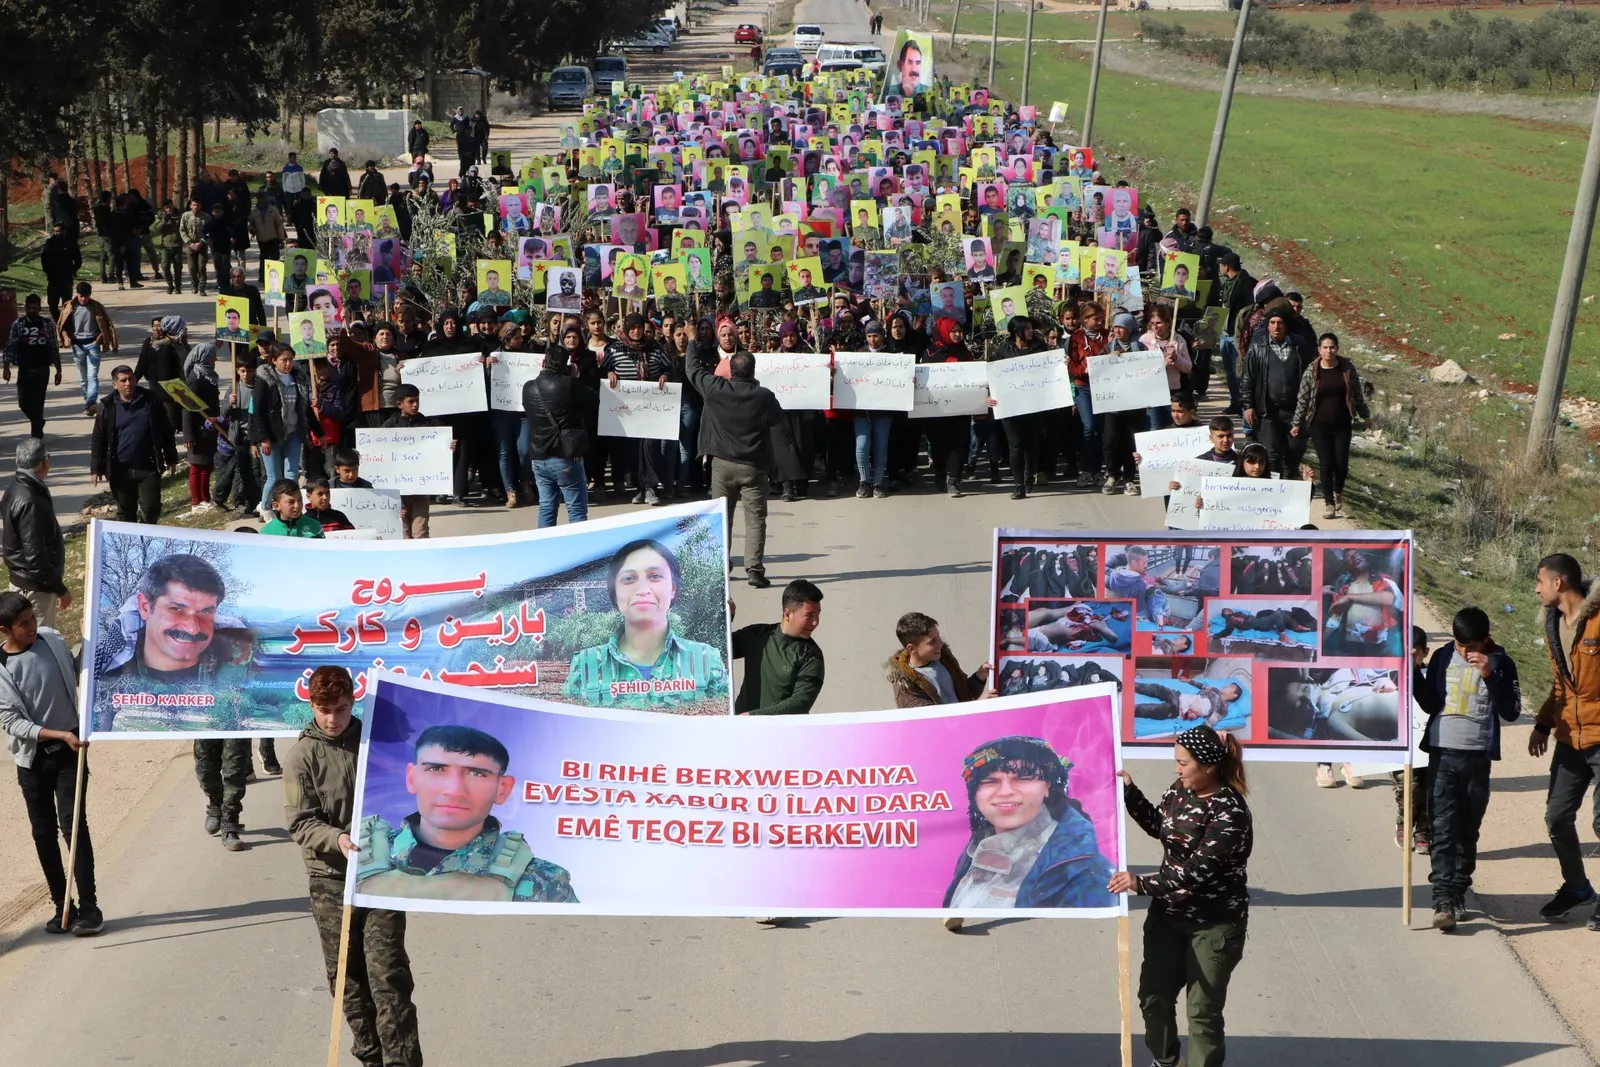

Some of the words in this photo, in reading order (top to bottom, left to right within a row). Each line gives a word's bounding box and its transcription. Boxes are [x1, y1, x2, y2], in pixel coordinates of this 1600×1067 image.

[400, 617, 421, 651] و
[438, 601, 547, 648] بارين
[654, 678, 696, 692] BARÎN
[157, 694, 214, 707] KARKER
[562, 760, 592, 780] BI
[598, 763, 669, 784] RIHÊ
[675, 764, 917, 787] BERXWEDANIYA
[644, 791, 749, 813] XABÛR
[757, 792, 778, 815] Û
[785, 792, 859, 815] ÎLAN
[865, 791, 953, 813] DARA
[556, 813, 621, 840] EMÊ
[626, 818, 724, 848] TEQEZ
[732, 821, 761, 846] BI
[768, 819, 919, 848] SERKEVIN
